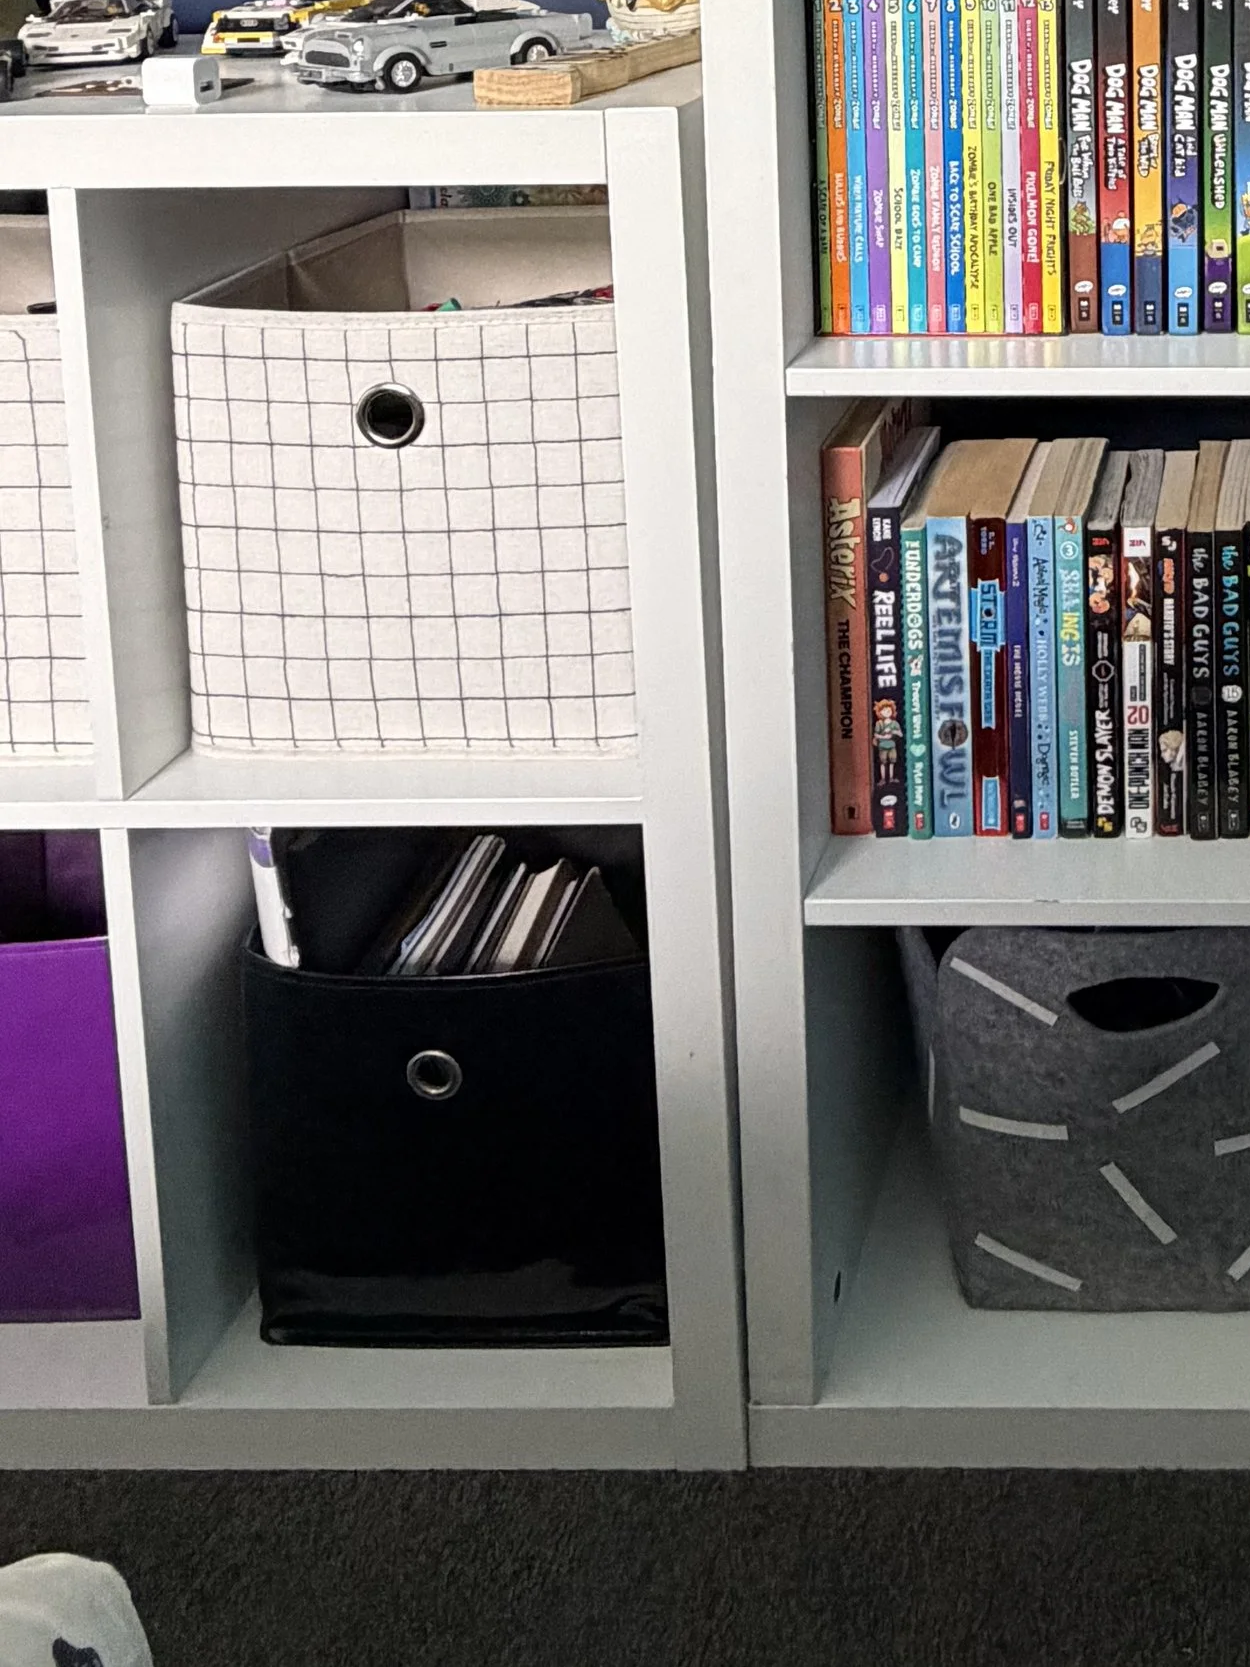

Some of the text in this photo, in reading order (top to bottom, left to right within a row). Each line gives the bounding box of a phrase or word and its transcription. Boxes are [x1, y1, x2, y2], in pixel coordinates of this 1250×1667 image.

[1071, 59, 1091, 132] DOG MAN
[1105, 63, 1125, 134] DOG MAN
[1138, 63, 1158, 130] DOG MAN
[1174, 54, 1197, 130] DOG MAN
[988, 182, 998, 256] ONE BAD APPLE
[1007, 188, 1018, 248] INSIDES OUT
[871, 517, 881, 542] LYNCH
[882, 518, 891, 540] KANE
[827, 497, 861, 739] Asterix THE CHAMPION
[905, 549, 922, 650] UNDERDOGS
[932, 534, 967, 700] ARTEMIS
[1192, 548, 1209, 678] the BAD GUYS
[1222, 546, 1239, 676] the BAD GUYS
[874, 590, 896, 688] REEL LIFE
[1069, 730, 1080, 800] STEVEN BUTLER
[1094, 710, 1114, 815] DEMON SLAYER
